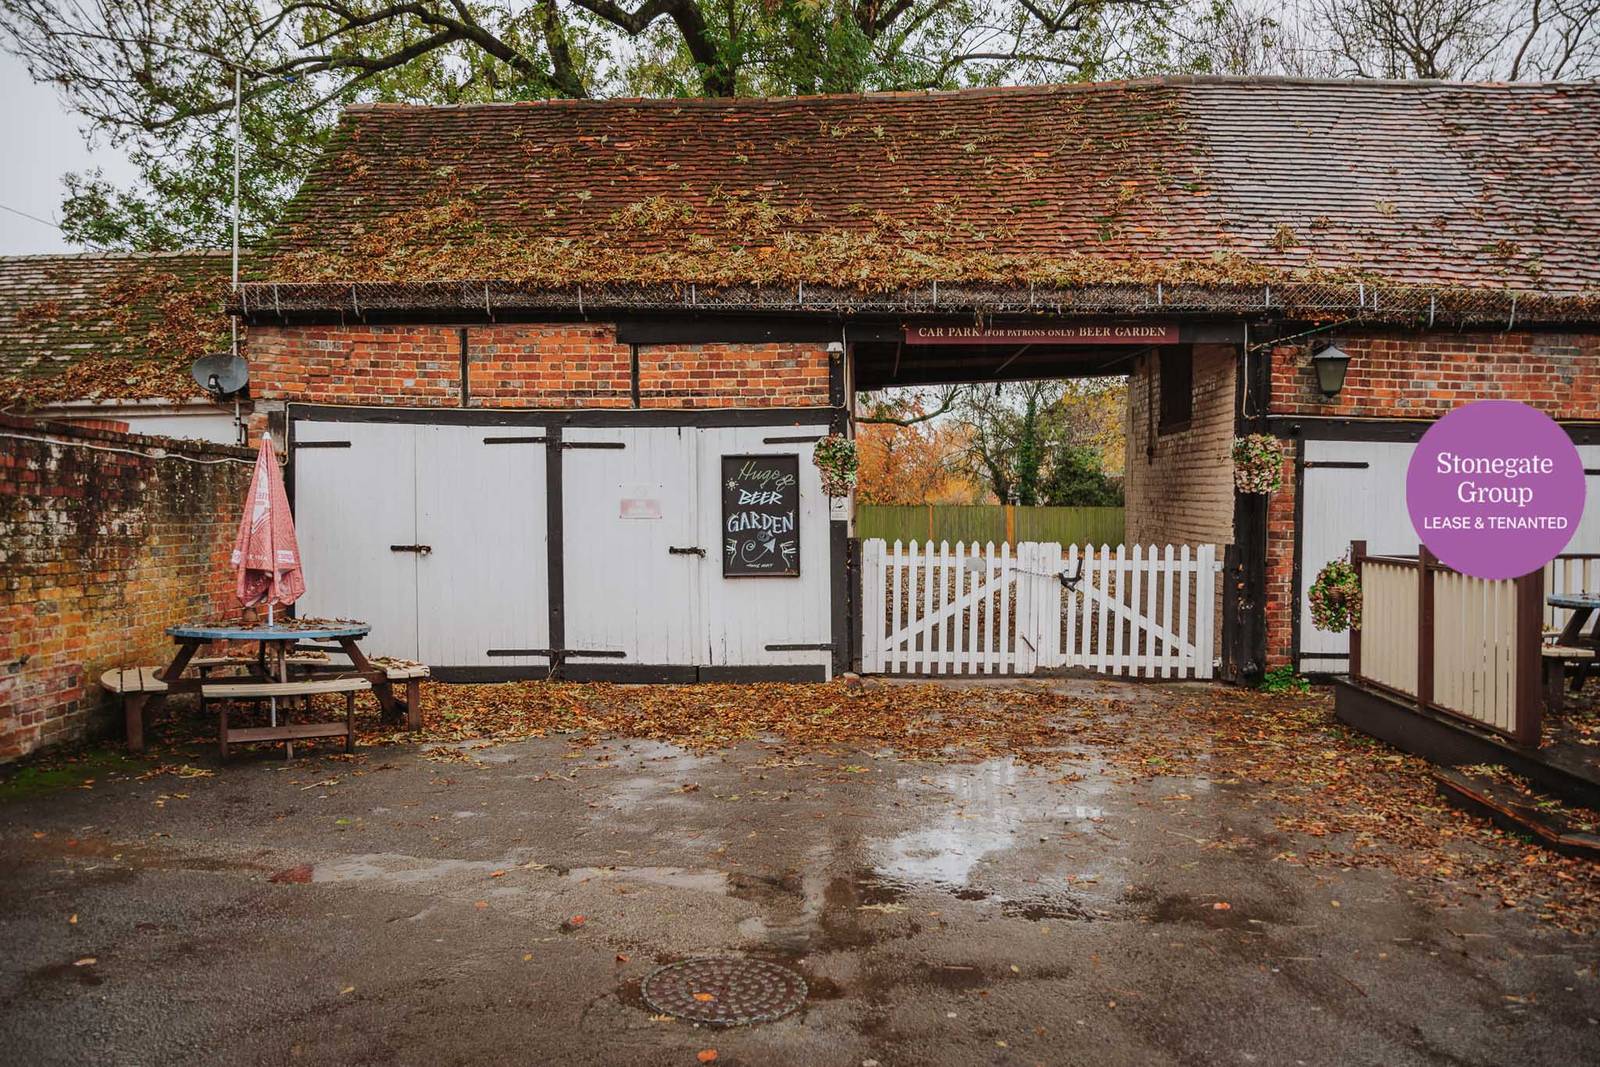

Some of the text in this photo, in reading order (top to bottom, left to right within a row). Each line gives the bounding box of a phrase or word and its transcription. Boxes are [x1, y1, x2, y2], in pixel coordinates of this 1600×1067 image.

[918, 327, 943, 337] CAR
[948, 327, 980, 337] PARK
[1007, 328, 1045, 337] PATRONS
[1079, 327, 1111, 337] BEER
[1114, 327, 1166, 337] GARDEN
[738, 489, 783, 505] BEER
[727, 510, 794, 533] GARDEN
